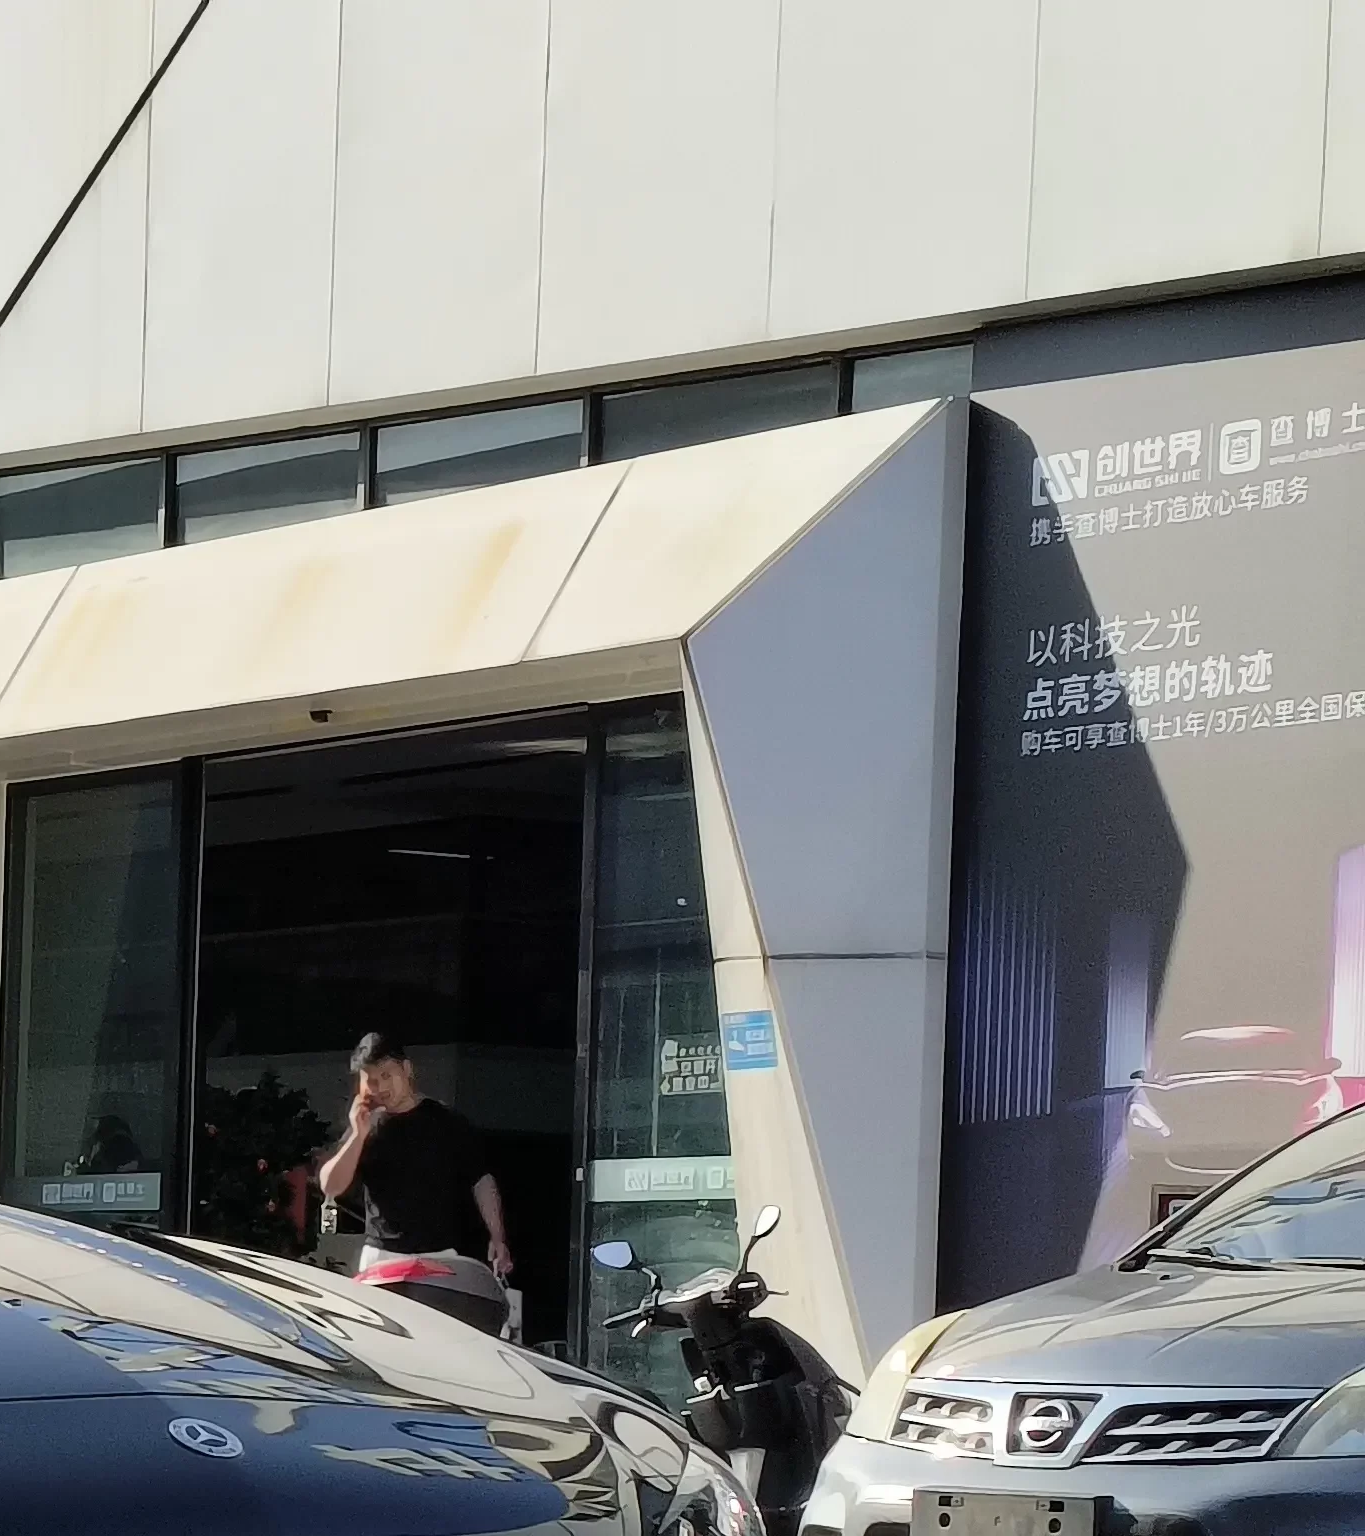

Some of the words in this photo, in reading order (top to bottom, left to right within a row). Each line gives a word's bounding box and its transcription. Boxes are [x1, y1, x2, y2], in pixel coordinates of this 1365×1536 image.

[1096, 428, 1202, 482] 创世界
[1029, 475, 1309, 548] 携手查博士打造放心车服务
[1026, 603, 1202, 667] 以科技之光
[1022, 649, 1274, 722] 点亮梦想的轨迹
